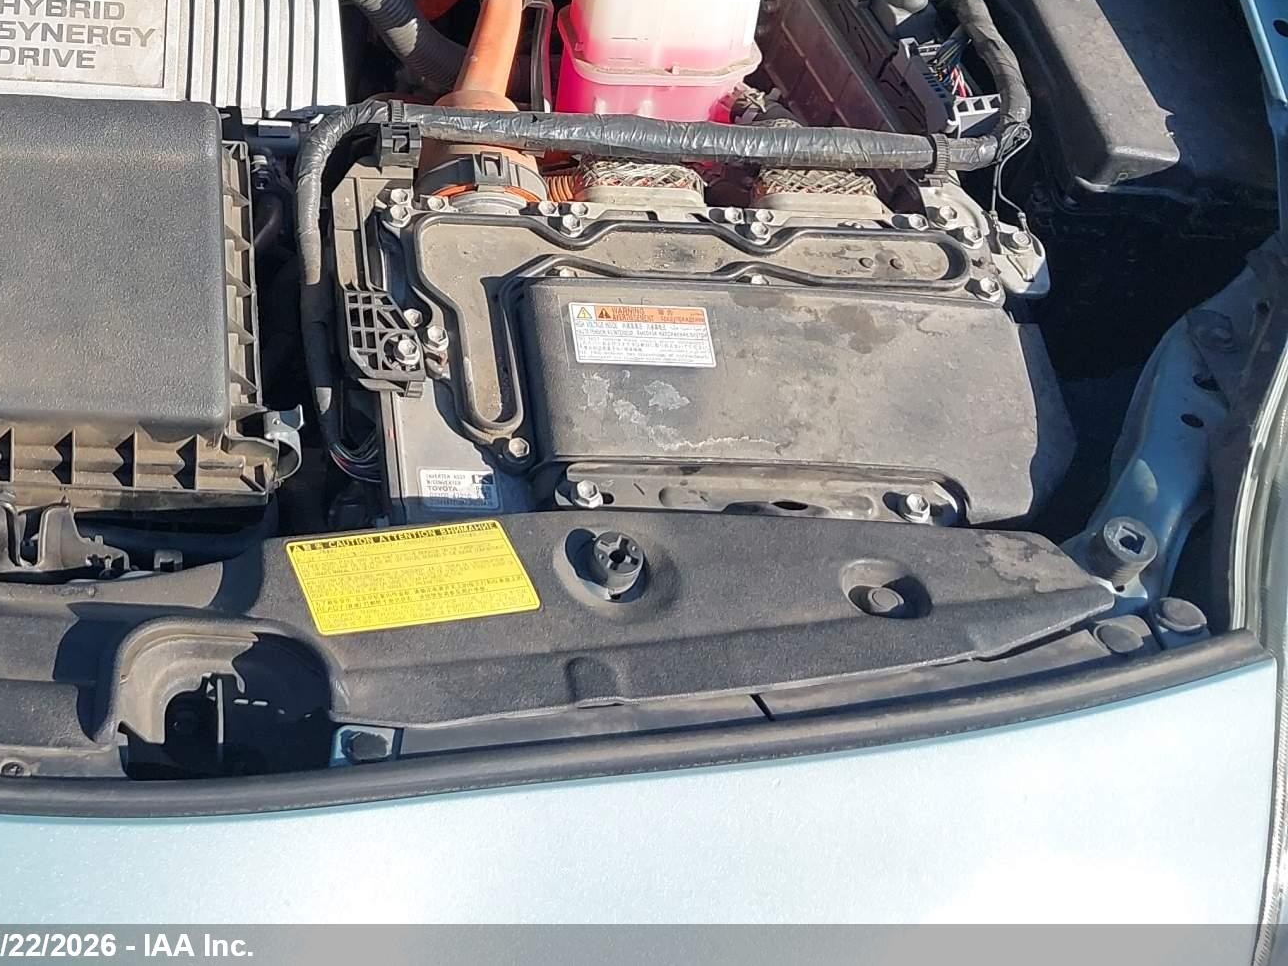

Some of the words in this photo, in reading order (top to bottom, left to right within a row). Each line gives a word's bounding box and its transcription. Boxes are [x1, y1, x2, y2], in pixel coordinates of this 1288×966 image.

[328, 537, 373, 547] CAUTION
[380, 530, 435, 542] ATTENTION
[441, 523, 495, 536] ВНИМАНИЕ
